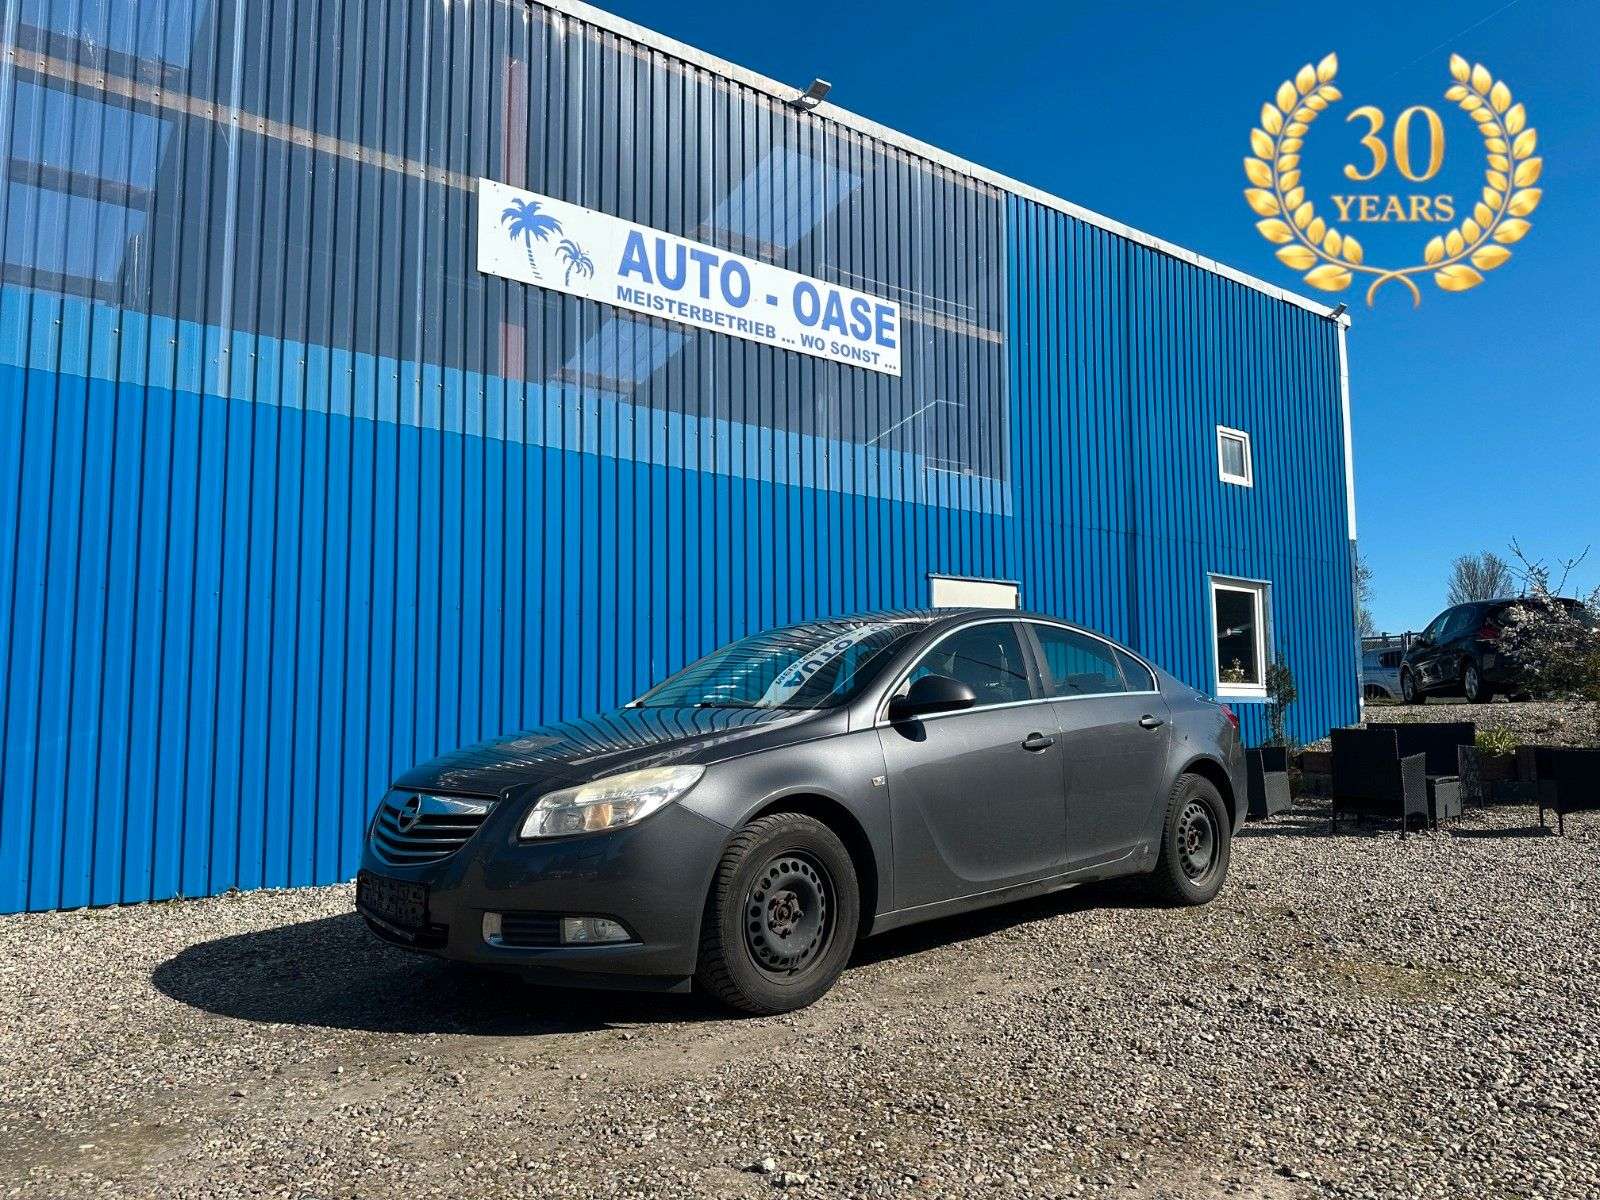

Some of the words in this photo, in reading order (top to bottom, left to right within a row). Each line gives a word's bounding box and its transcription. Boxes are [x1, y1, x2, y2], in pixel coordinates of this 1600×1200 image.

[616, 285, 777, 340] MEISTERBETRIEB
[800, 333, 826, 352] WO
[830, 341, 881, 366] SONST
[617, 229, 751, 309] AUTO
[792, 281, 897, 350] OASE
